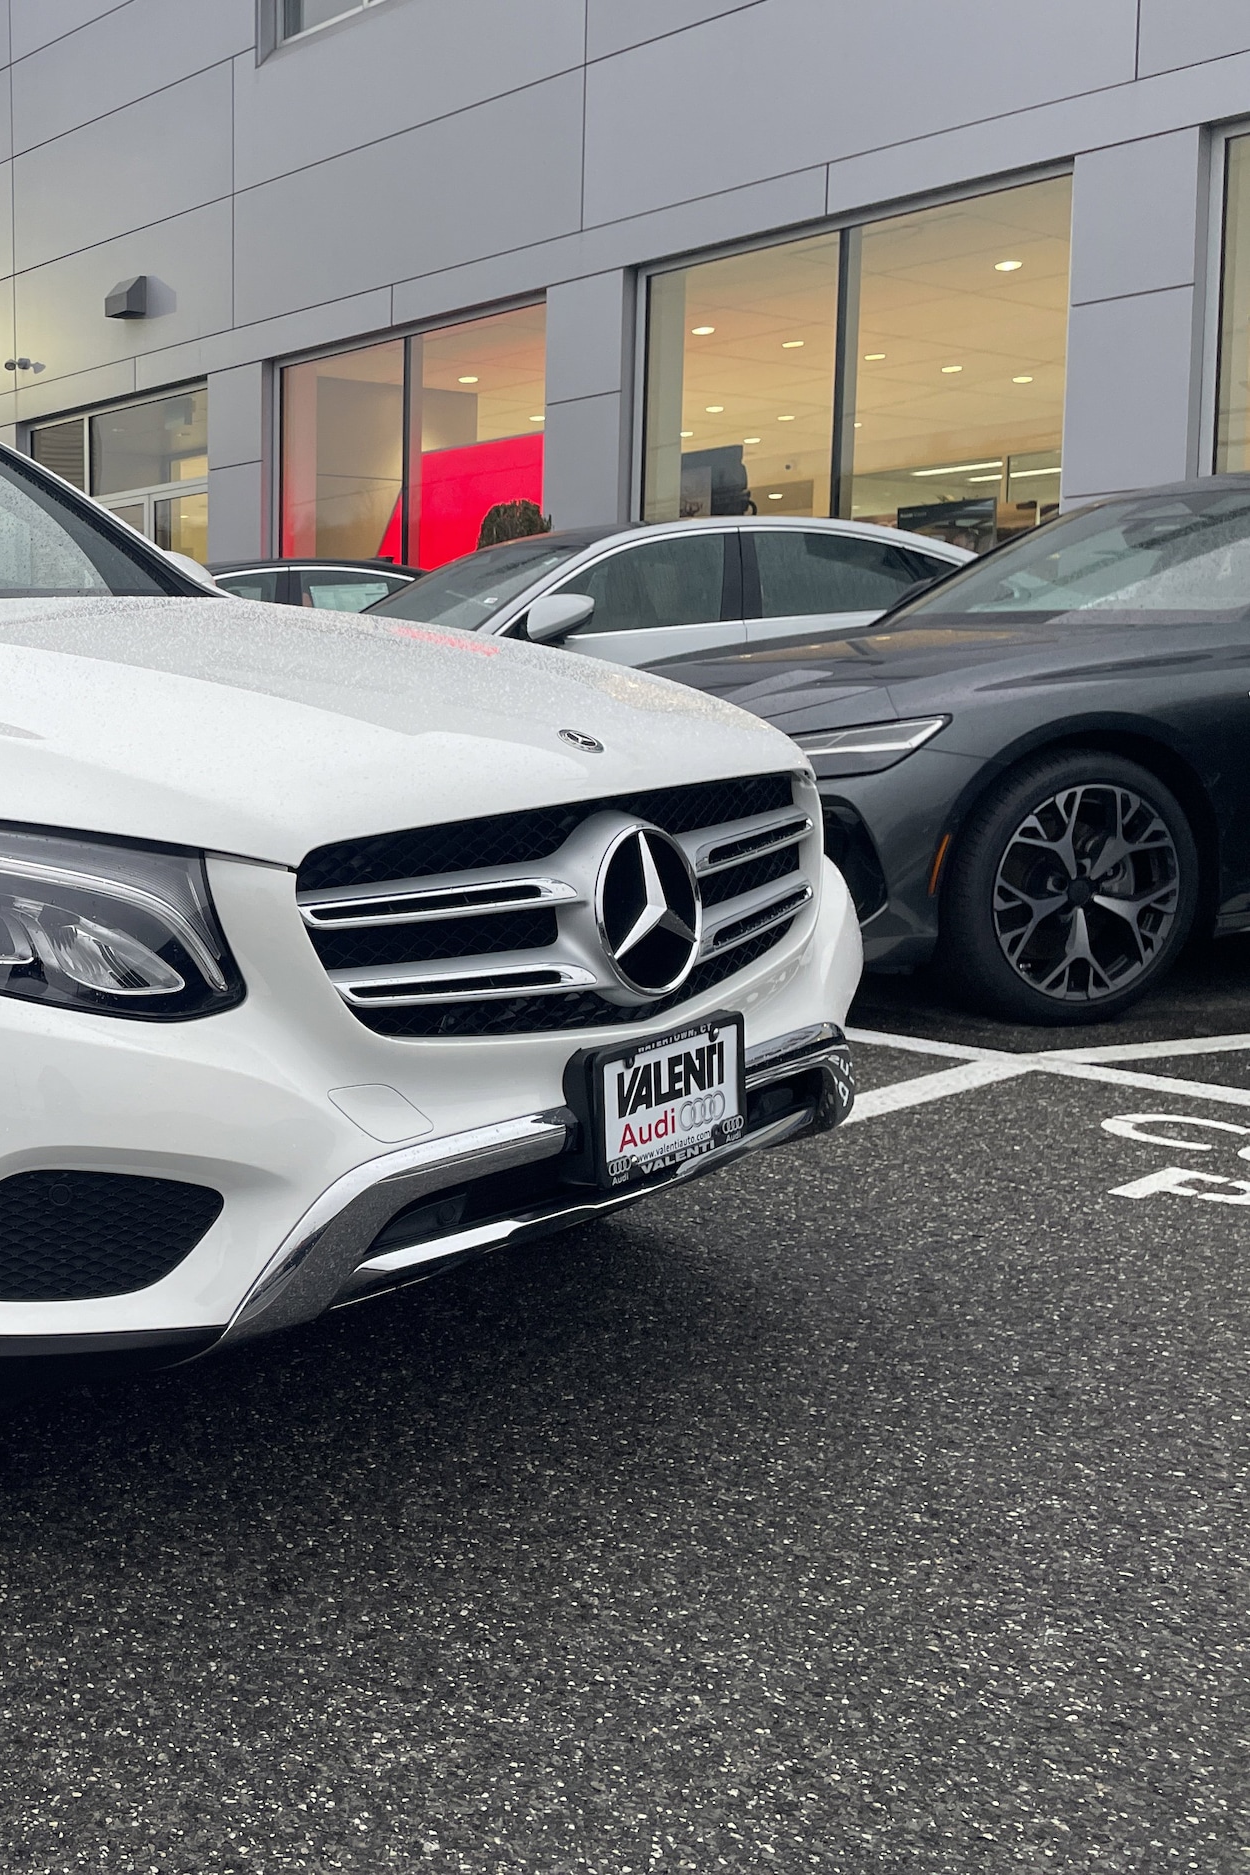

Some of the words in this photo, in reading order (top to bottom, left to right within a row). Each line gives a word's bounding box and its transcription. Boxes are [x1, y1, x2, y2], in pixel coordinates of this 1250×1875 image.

[700, 1022, 713, 1034] CT
[616, 1040, 725, 1119] VALENTI
[618, 1107, 676, 1153] Audi
[637, 1129, 711, 1164] www.valentiauto.com
[725, 1132, 742, 1144] Audi
[640, 1139, 715, 1175] VALENTI
[611, 1172, 629, 1187] Audi
